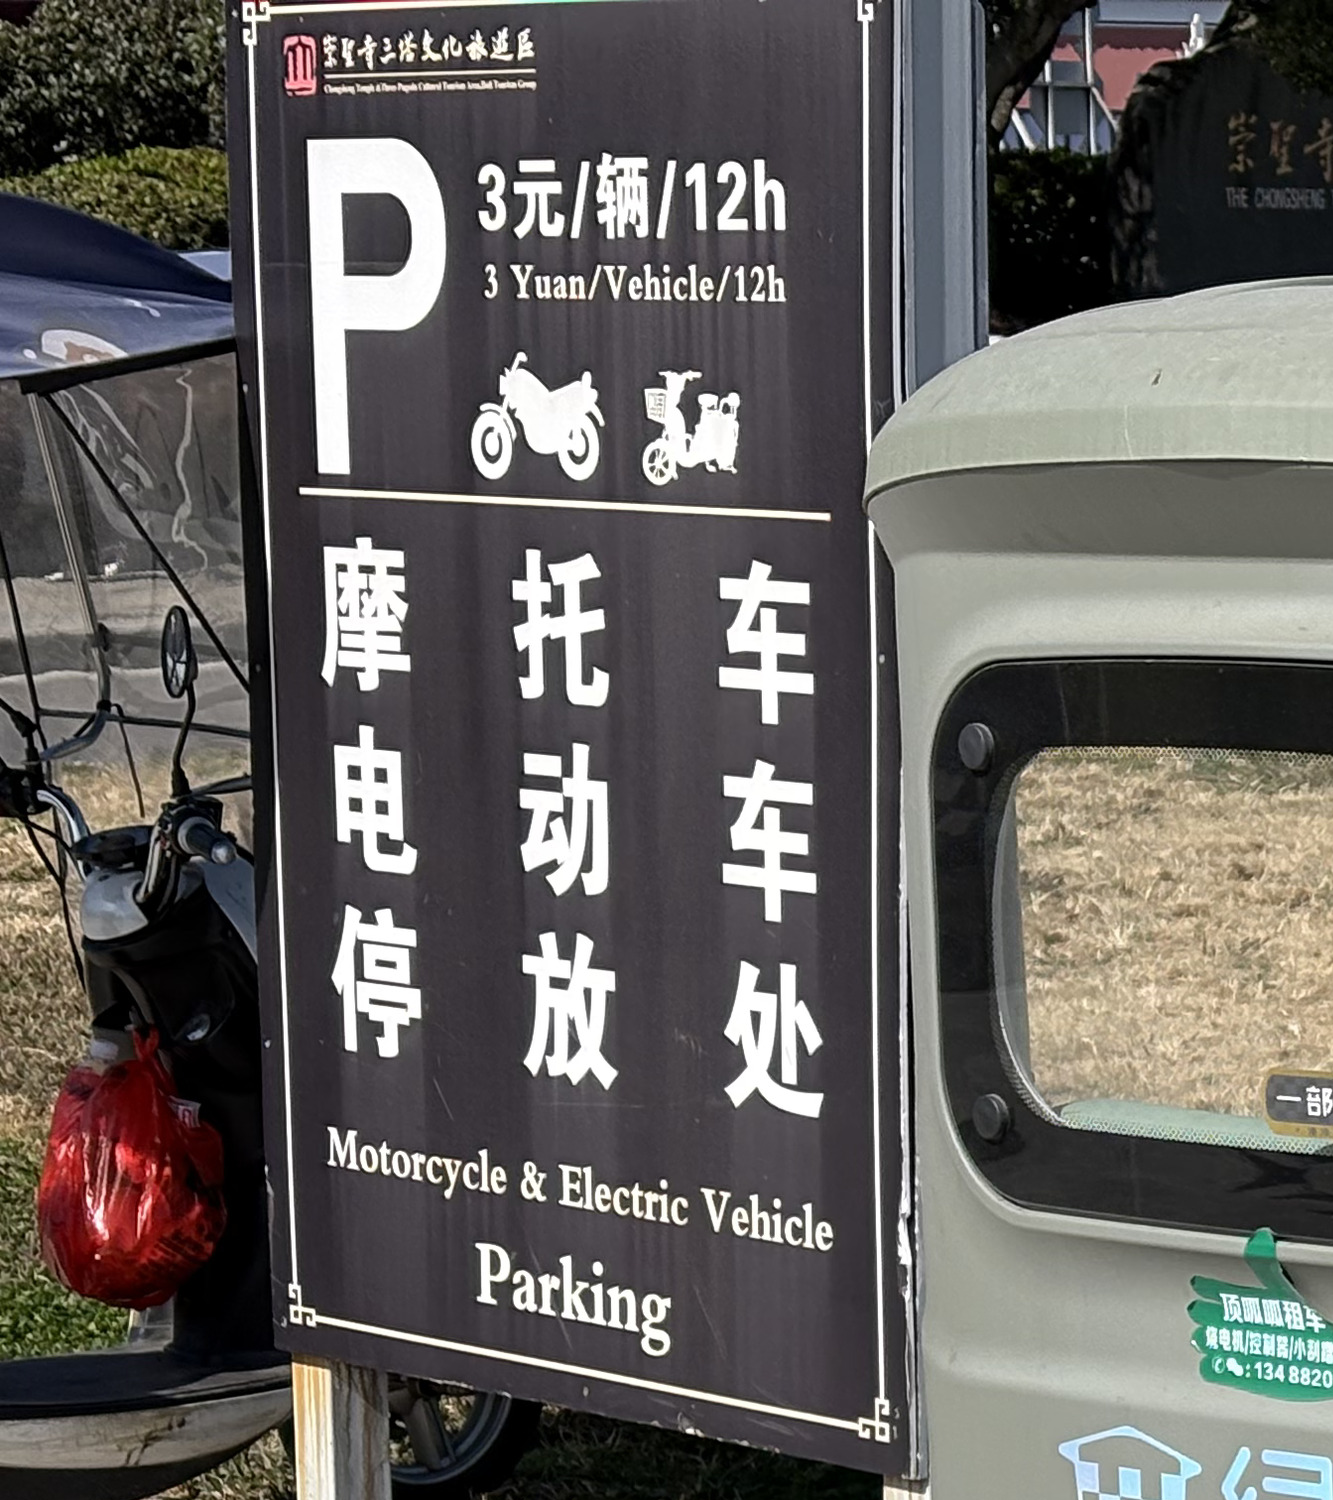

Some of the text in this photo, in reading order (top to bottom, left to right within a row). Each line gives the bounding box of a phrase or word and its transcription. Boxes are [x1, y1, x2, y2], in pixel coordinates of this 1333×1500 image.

[477, 152, 787, 240] 3元/辆/12h
[1226, 187, 1248, 208] THE
[1254, 187, 1325, 210] CHONGSHENG
[306, 137, 447, 475] P
[484, 262, 787, 303] 3 Yuan/Vehicle/12h
[327, 1126, 834, 1251] Motorcycle & Electric Vehicle
[475, 1242, 672, 1357] Parking
